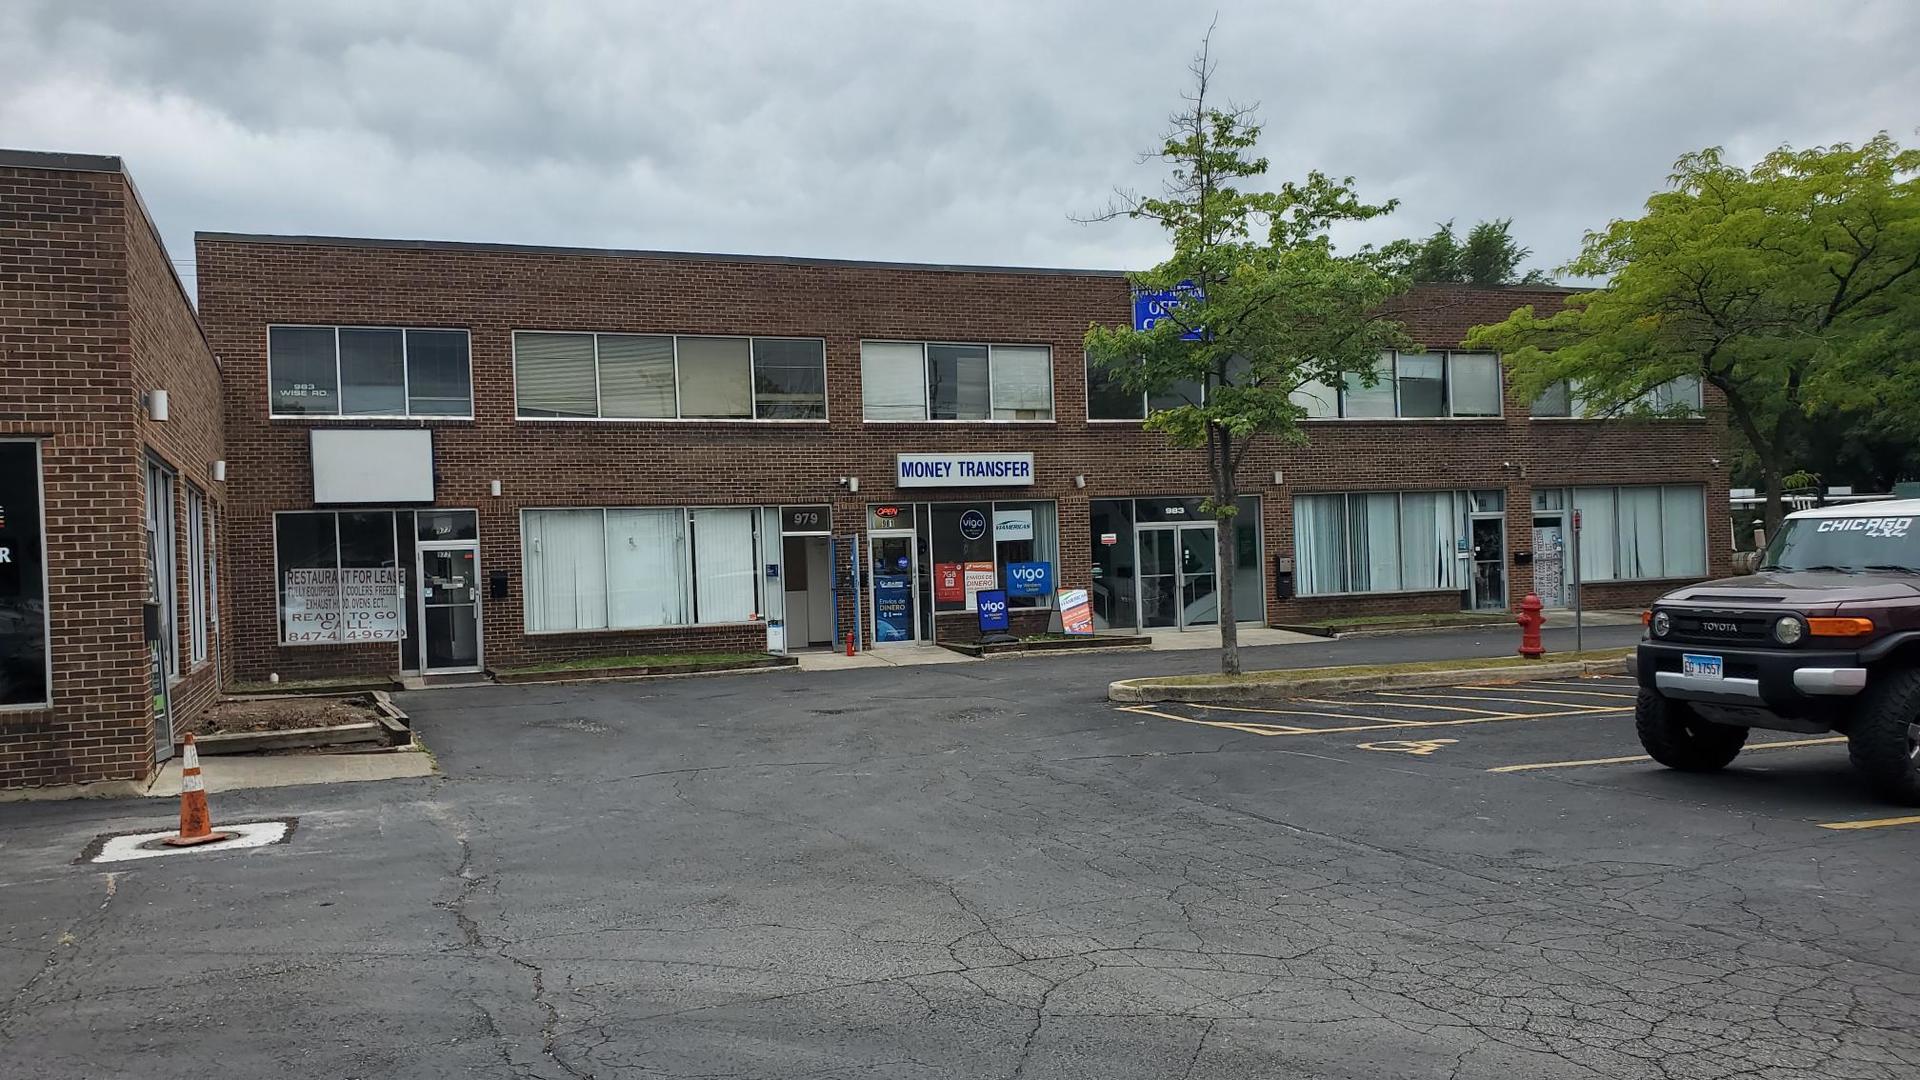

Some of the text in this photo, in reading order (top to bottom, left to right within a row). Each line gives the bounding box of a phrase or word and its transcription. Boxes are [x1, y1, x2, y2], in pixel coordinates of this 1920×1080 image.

[901, 461, 1030, 478] MONEY TRANSFER
[877, 507, 898, 516] OPEN
[794, 513, 818, 525] 979
[963, 517, 983, 528] vigo
[1817, 518, 1912, 532] CHICAGO
[287, 570, 404, 584] RESTAURANT FOR LEASE
[1013, 565, 1044, 581] vigo
[980, 600, 1005, 612] vigo
[350, 612, 369, 620] TO
[375, 611, 396, 619] GO
[1702, 622, 1738, 632] TOYOTA
[289, 630, 405, 641] 847-44-9670
